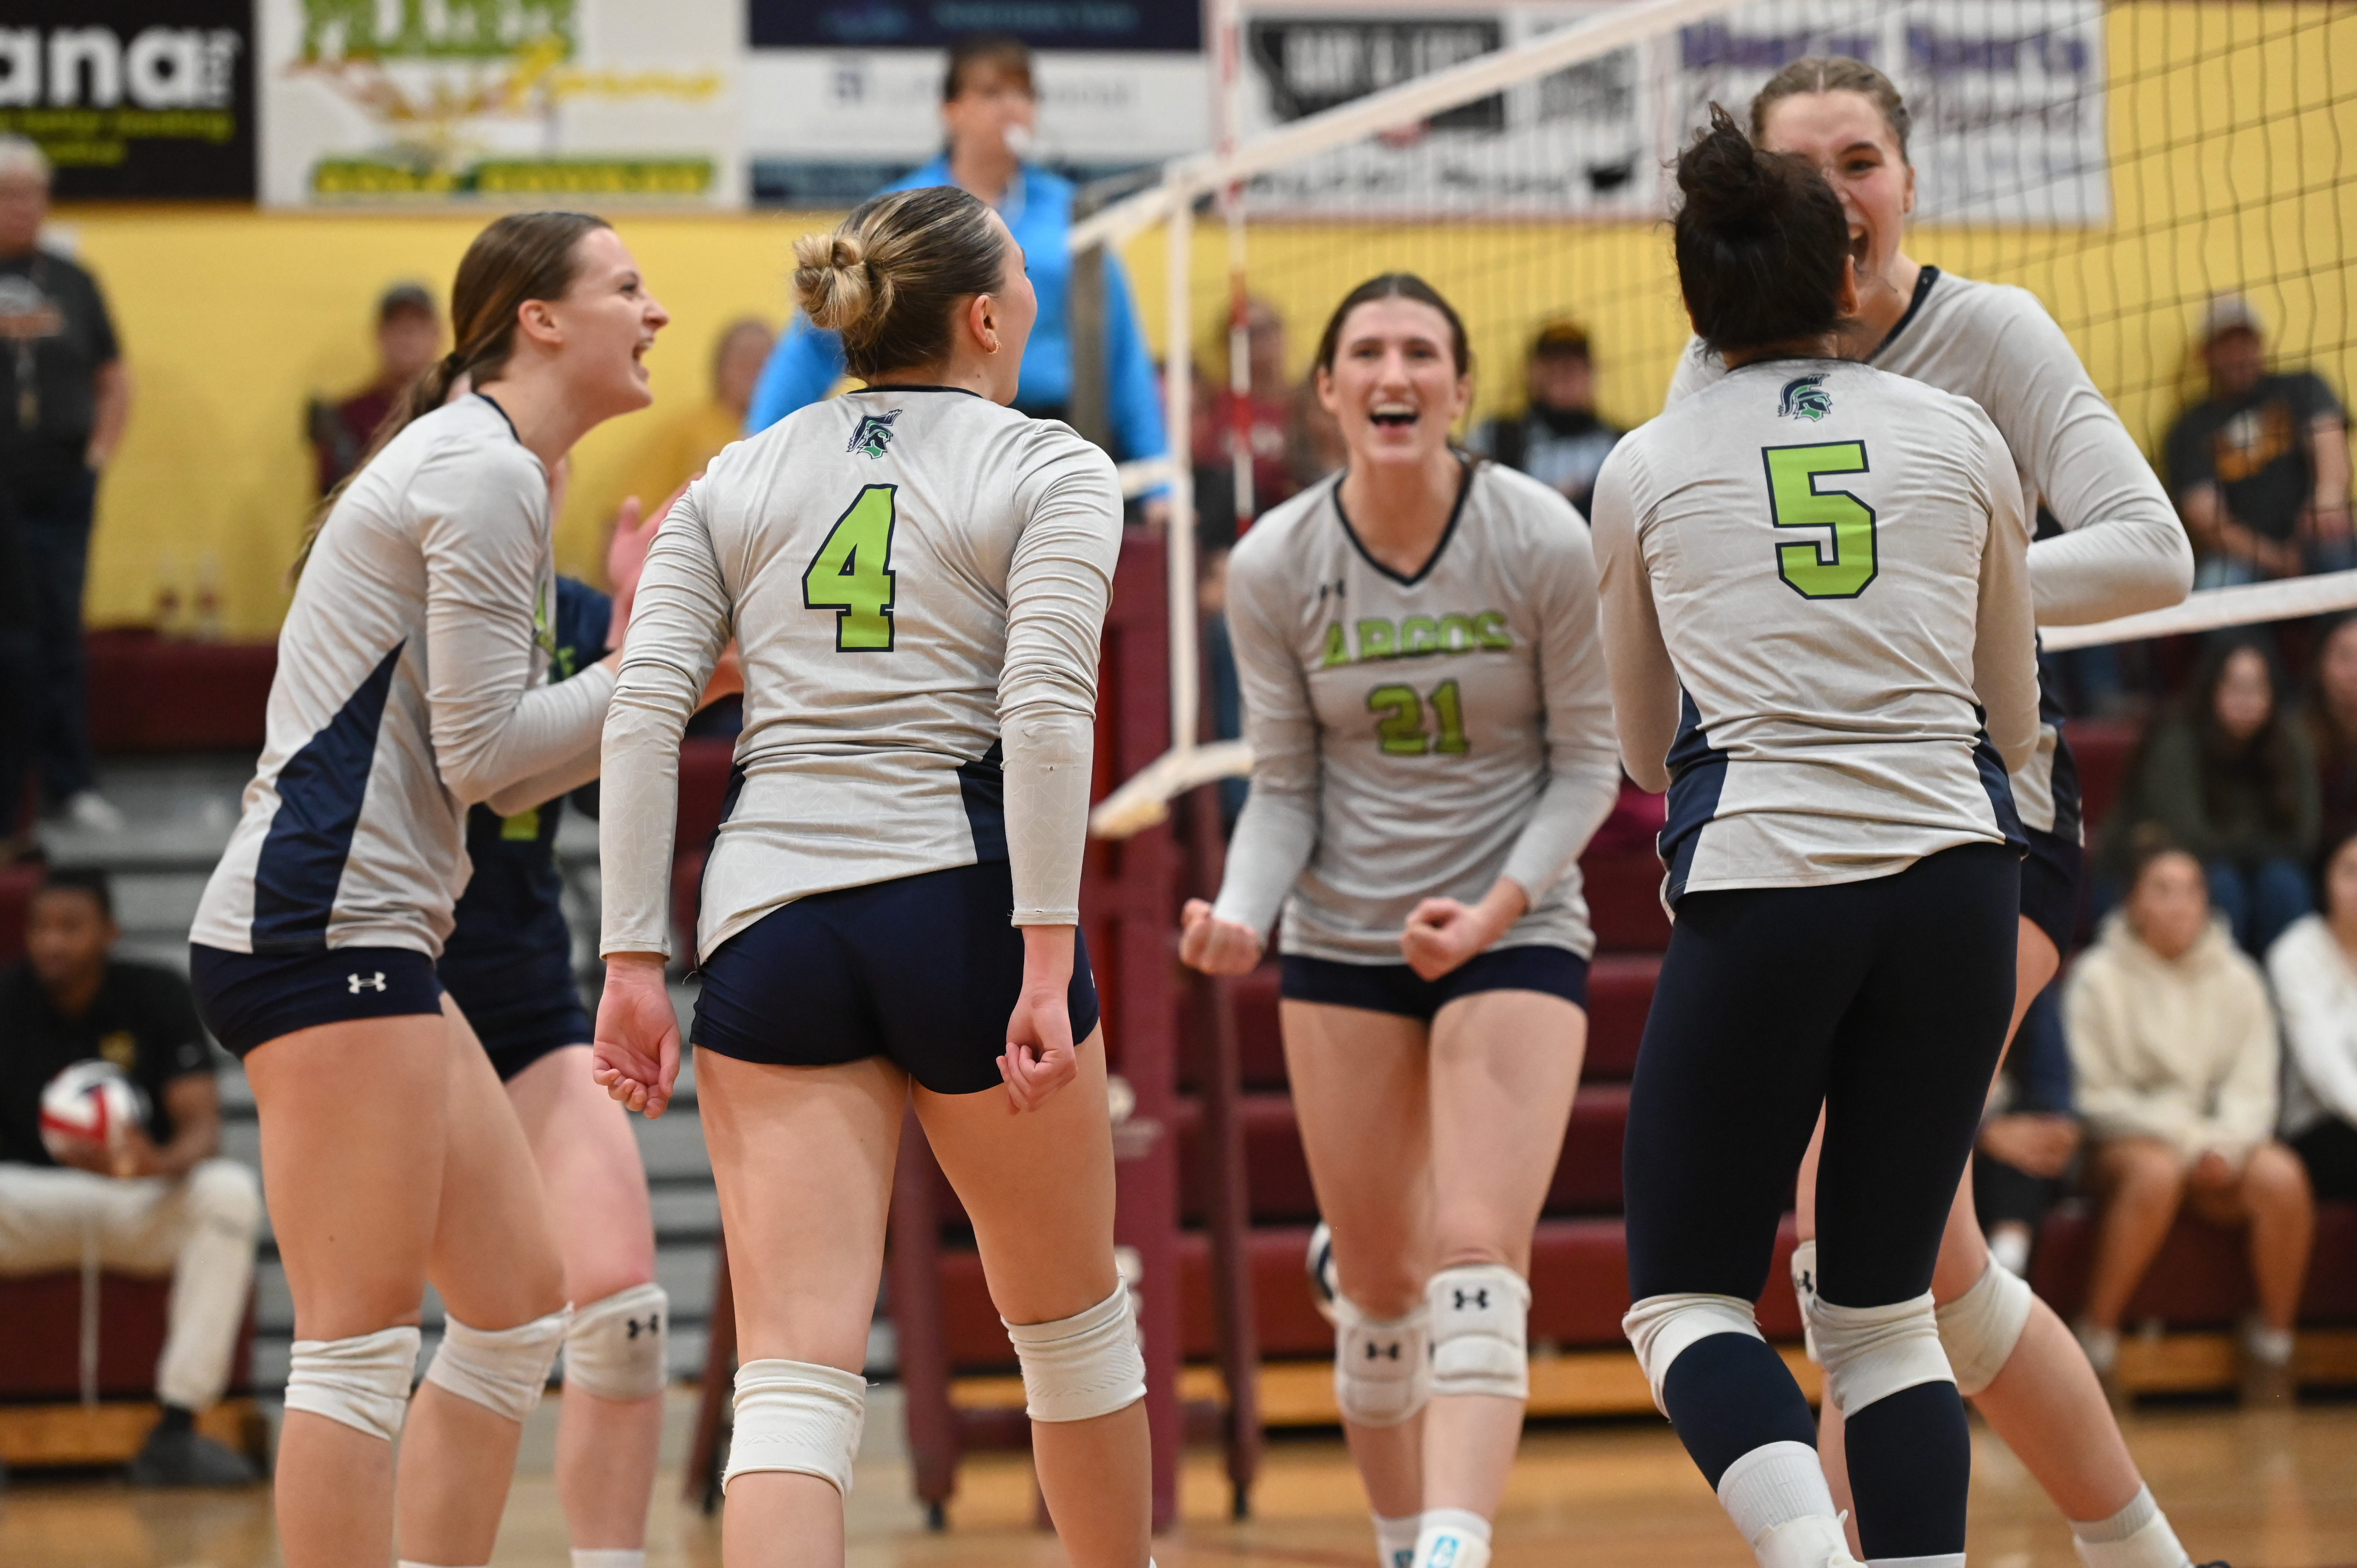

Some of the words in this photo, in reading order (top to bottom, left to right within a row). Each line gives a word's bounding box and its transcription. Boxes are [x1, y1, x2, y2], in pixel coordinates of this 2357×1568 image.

[802, 484, 898, 653] 4
[1761, 440, 1878, 600] 5
[1320, 610, 1514, 669] ARGOS
[1366, 678, 1471, 756] 21
